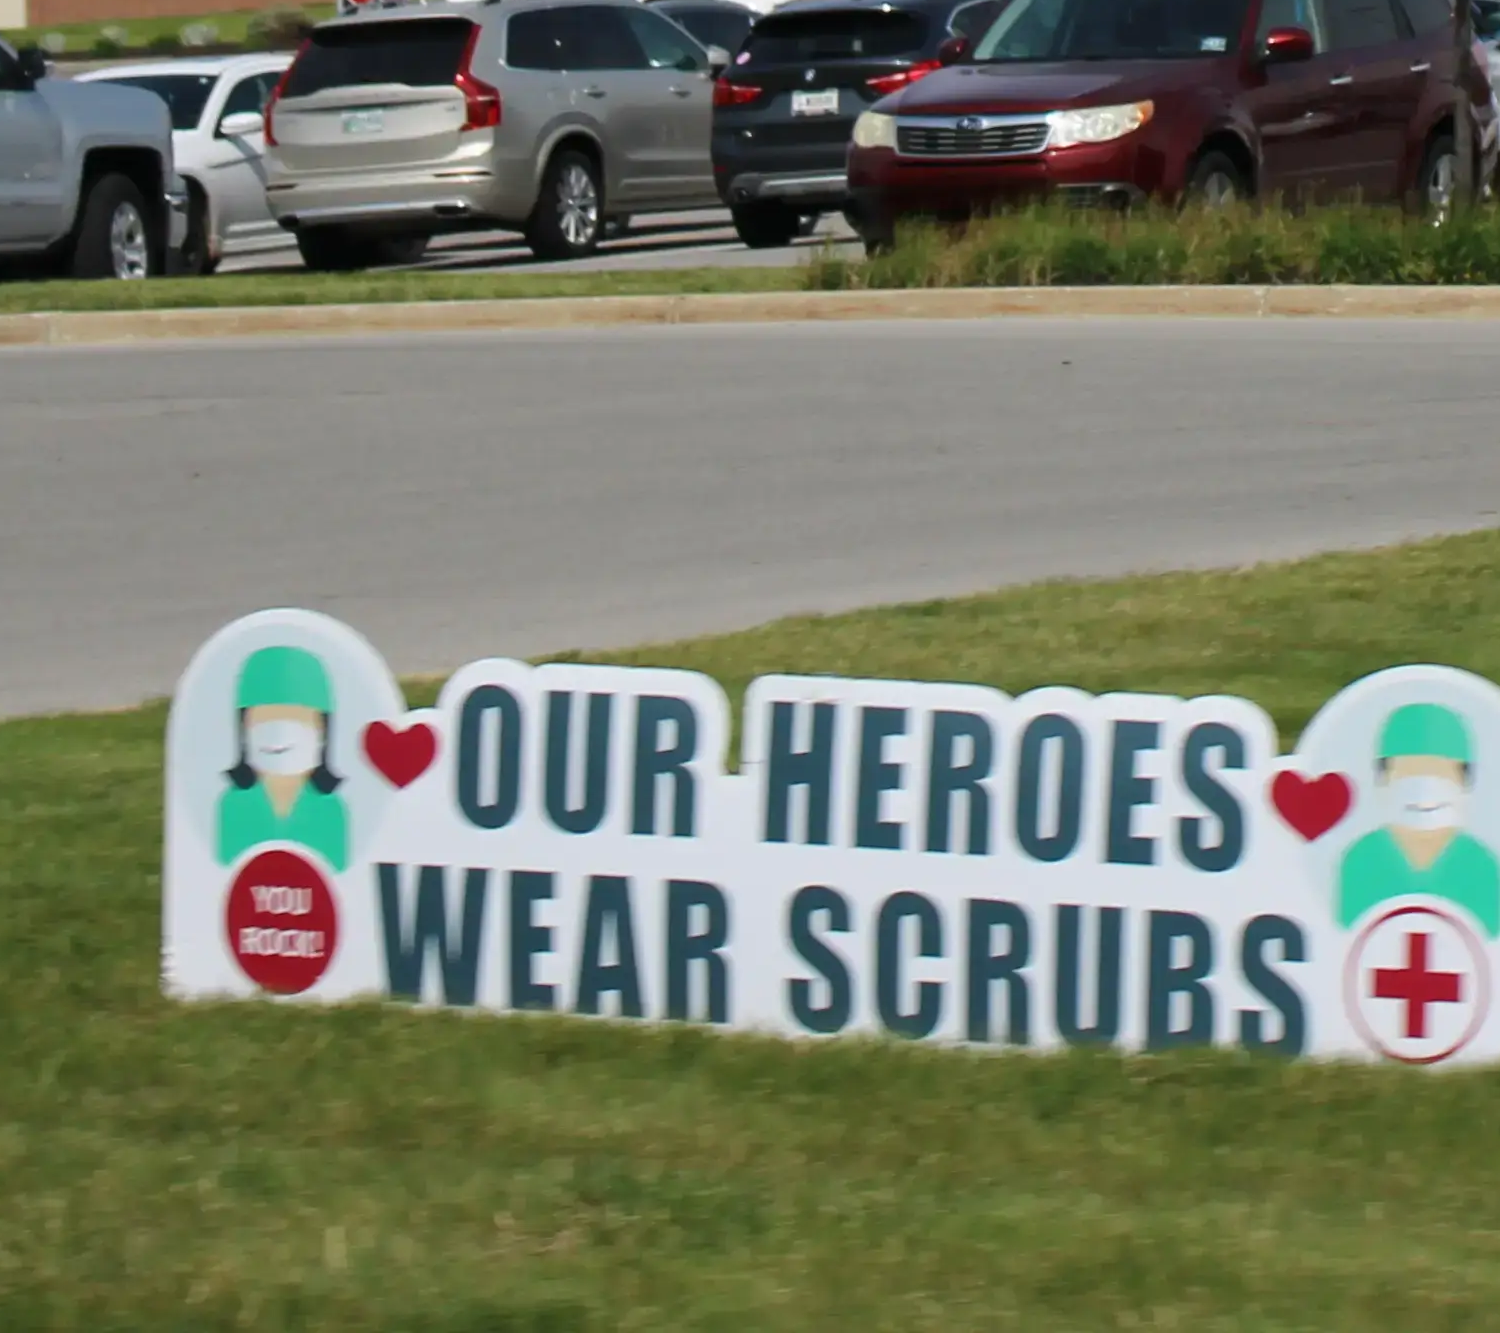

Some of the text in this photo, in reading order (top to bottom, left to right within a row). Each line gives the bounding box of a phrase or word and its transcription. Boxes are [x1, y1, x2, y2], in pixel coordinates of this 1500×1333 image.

[456, 683, 1246, 873] OUR HEROES
[250, 886, 313, 915] YOU
[373, 862, 1314, 1055] WEAR SCRUBS
